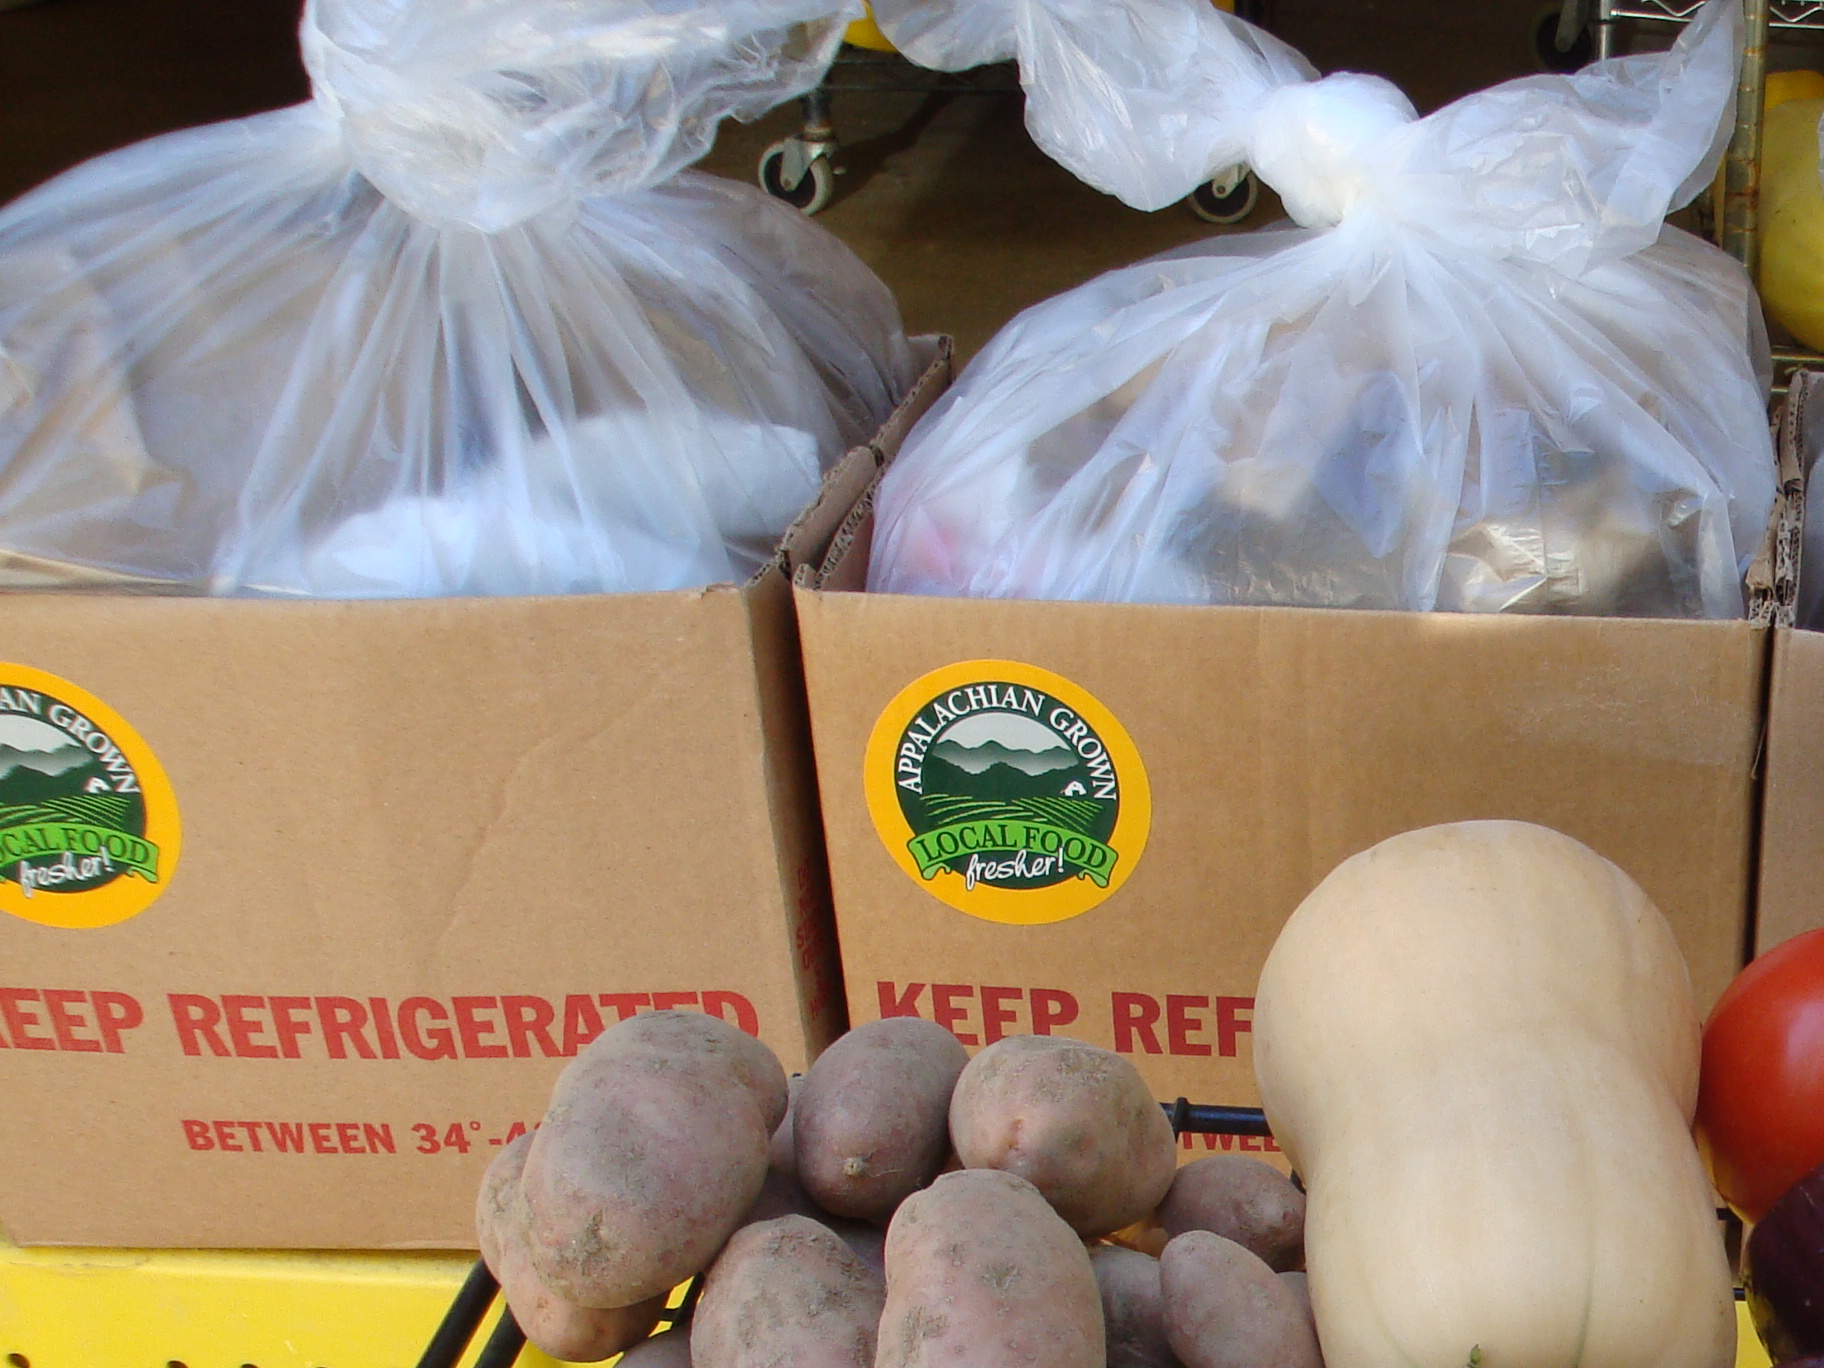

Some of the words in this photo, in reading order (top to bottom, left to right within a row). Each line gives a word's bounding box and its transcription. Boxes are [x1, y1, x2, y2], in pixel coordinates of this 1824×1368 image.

[50, 704, 141, 793] GROWN
[898, 685, 1046, 794] APPALACHIAN
[1049, 707, 1117, 800] GROWN
[0, 827, 60, 863] CAL
[60, 827, 149, 864] FOOD
[18, 845, 115, 899] fresher!
[917, 824, 1017, 862] LOCAL
[1022, 826, 1108, 869] FOOD
[965, 846, 1064, 891] fresher!
[0, 987, 144, 1054] EEP
[877, 981, 1080, 1046] KEEP
[182, 1119, 397, 1155] BETWEEN
